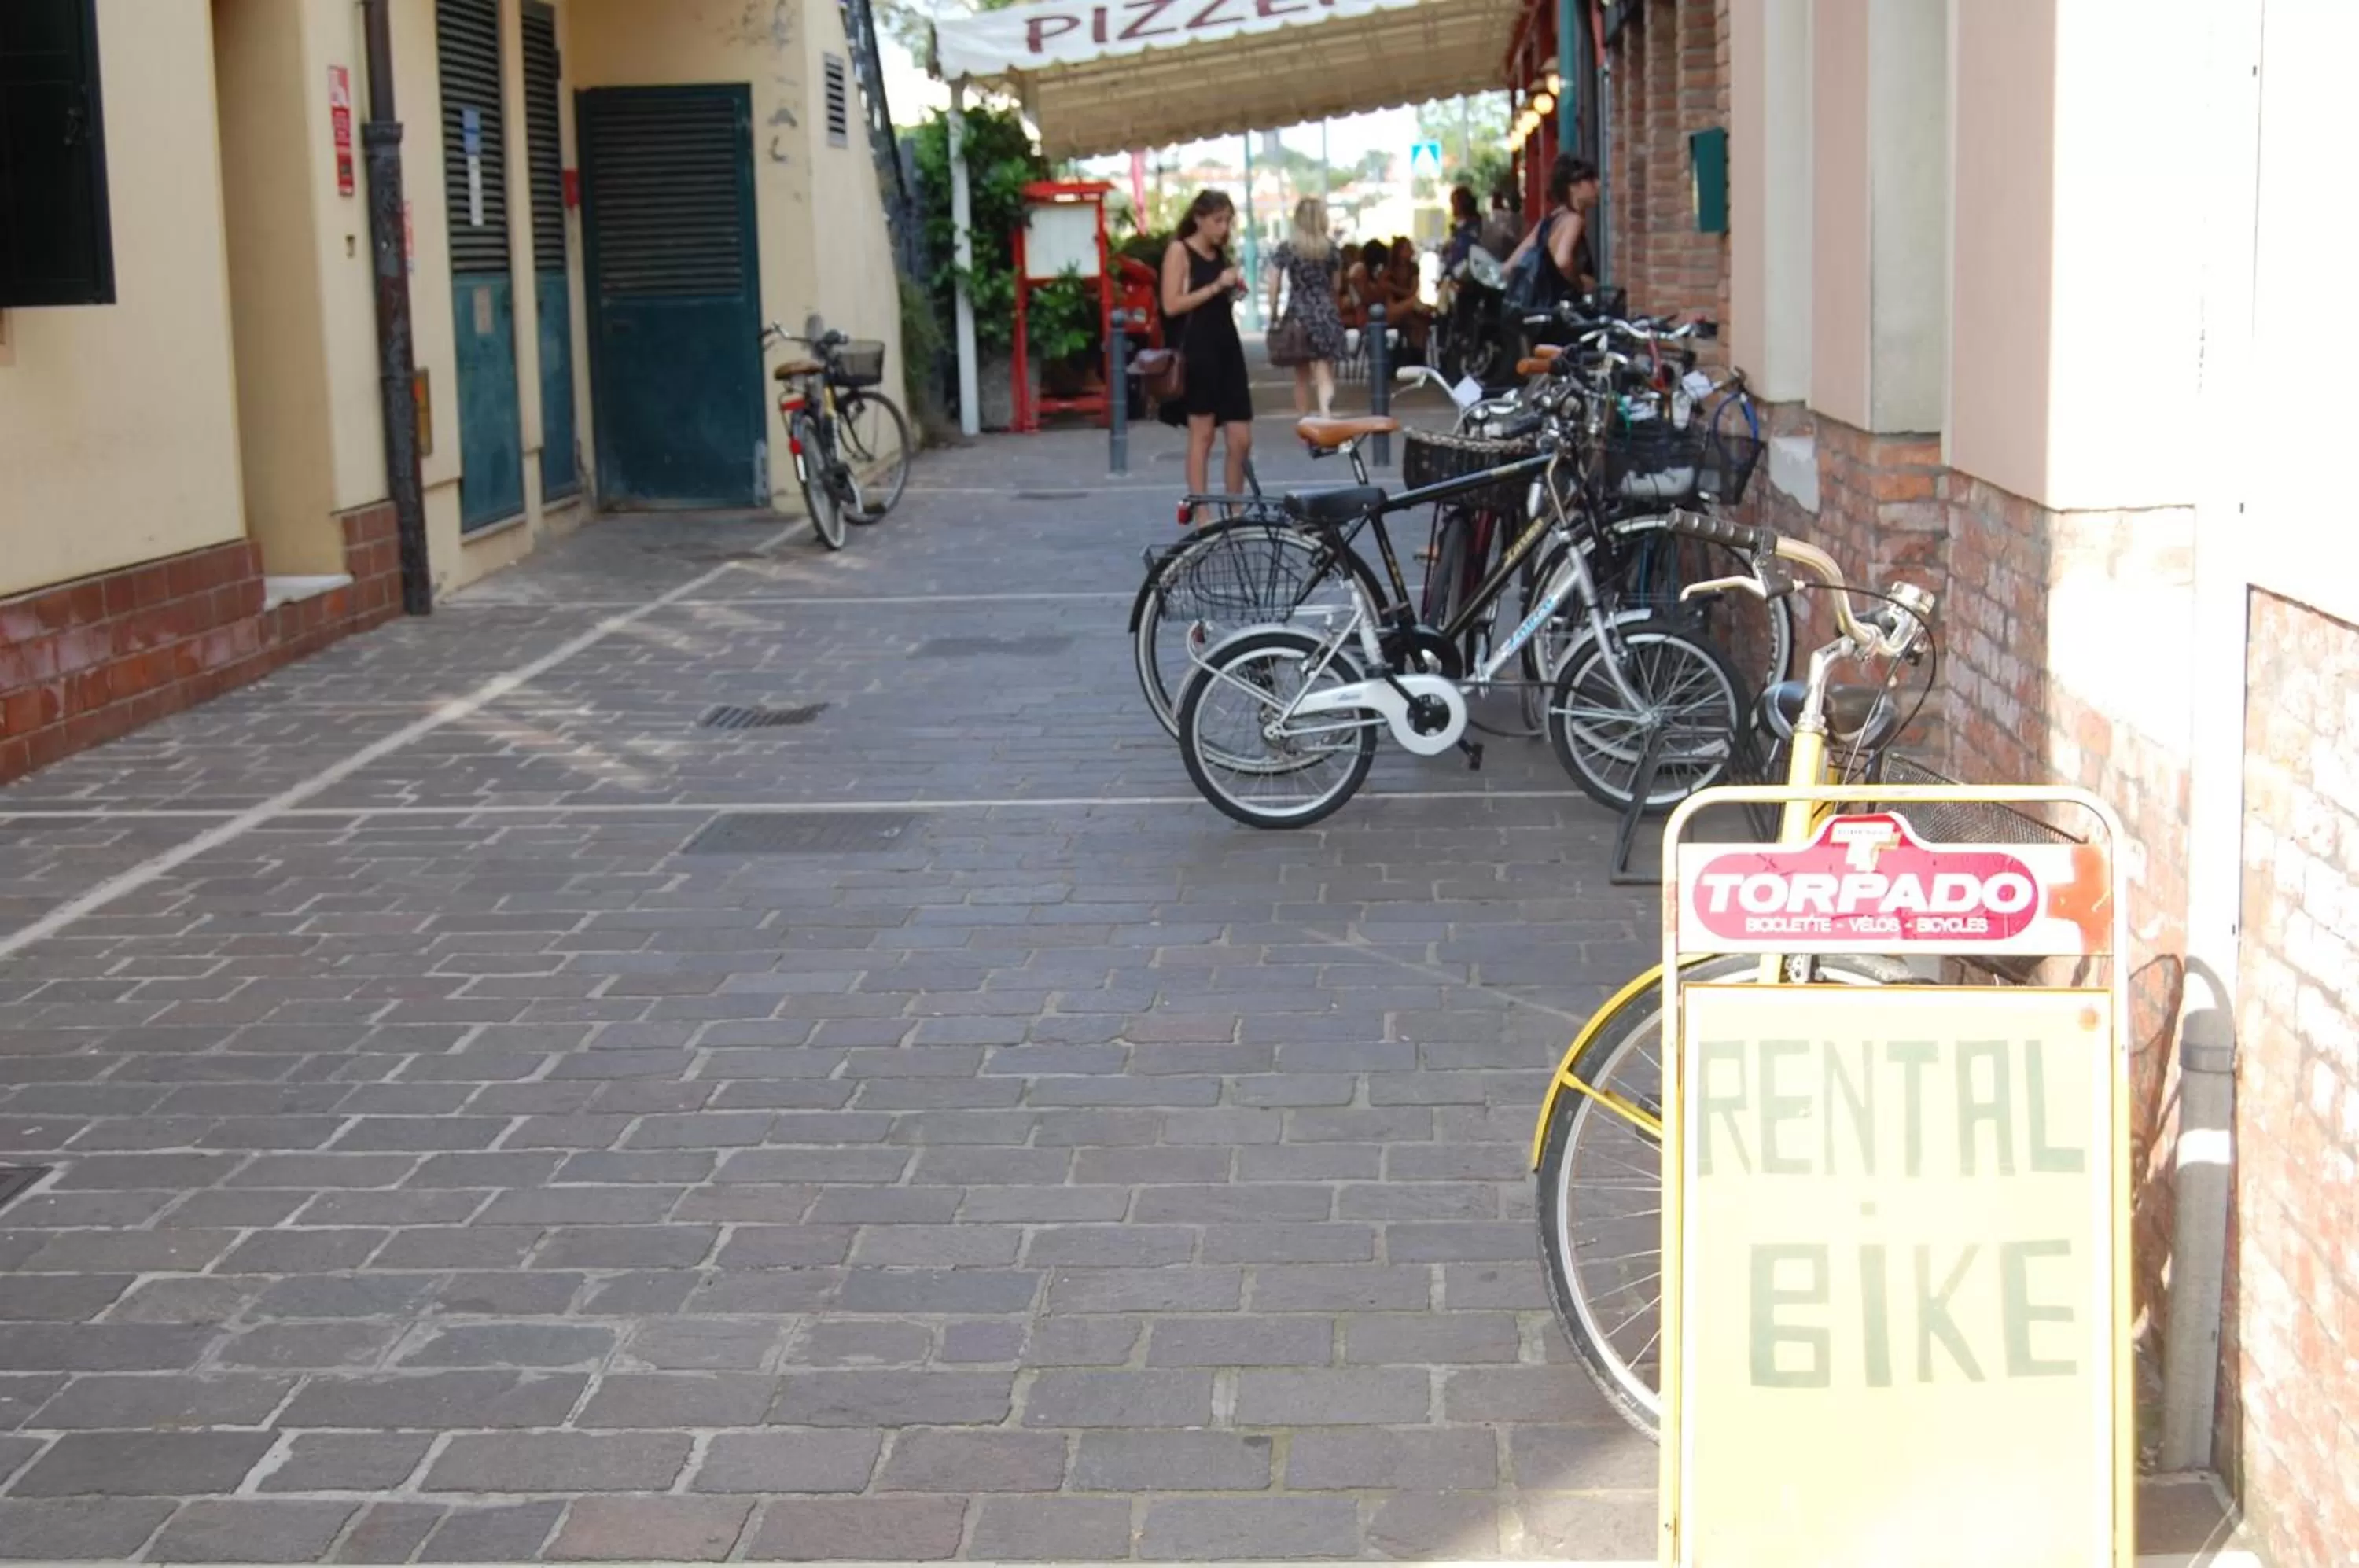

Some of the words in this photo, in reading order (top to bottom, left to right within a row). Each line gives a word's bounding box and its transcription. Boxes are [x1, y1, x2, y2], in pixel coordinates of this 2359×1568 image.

[1025, 0, 1335, 53] PIZZ
[1702, 872, 2033, 914] TORPADO
[1916, 918, 1989, 933] BICYCLES
[1697, 1040, 2085, 1177] RENTAL
